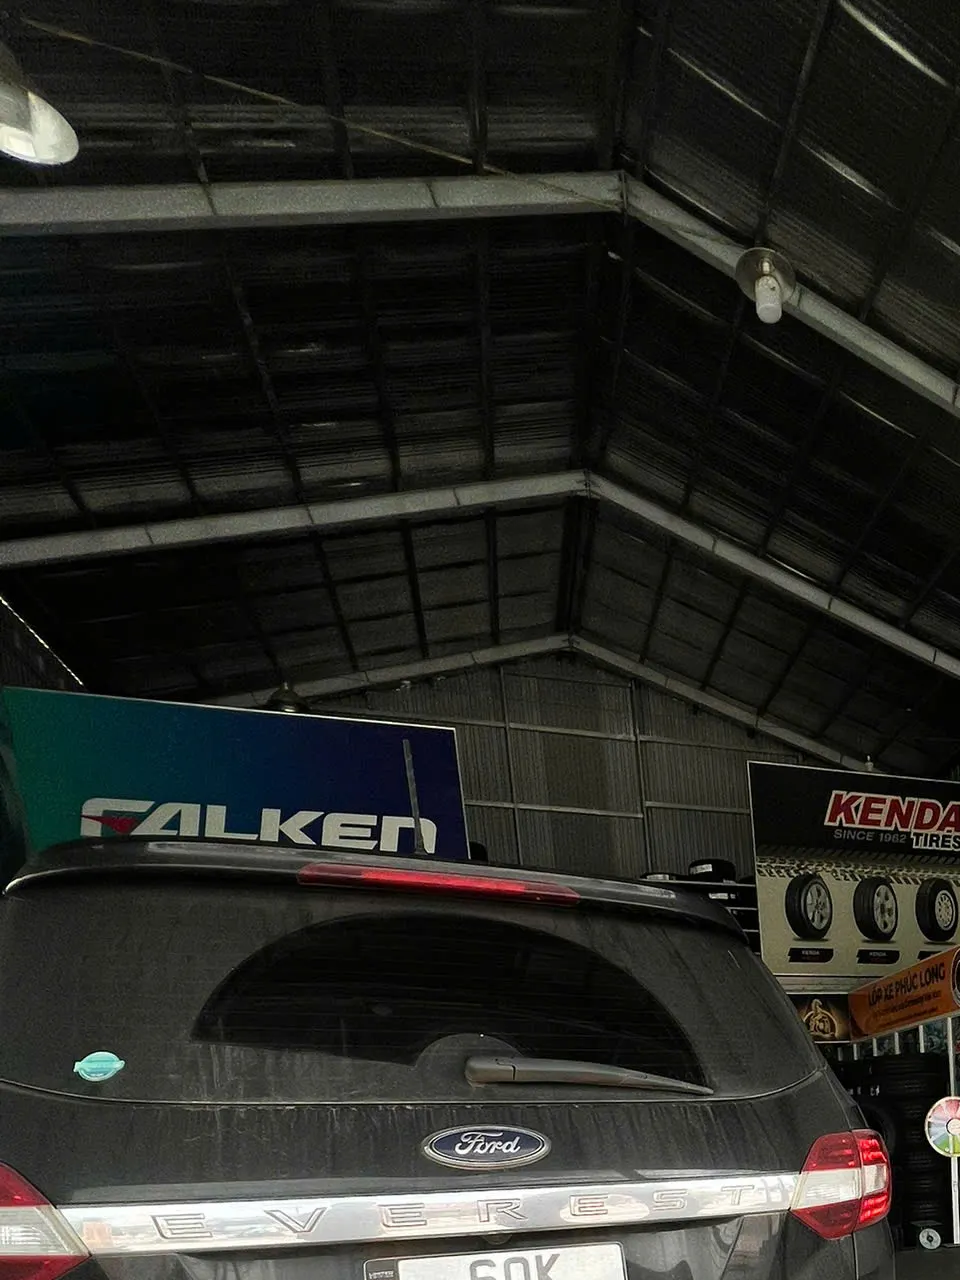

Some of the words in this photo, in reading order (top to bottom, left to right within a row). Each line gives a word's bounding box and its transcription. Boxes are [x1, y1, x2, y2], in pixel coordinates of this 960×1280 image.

[80, 797, 436, 854] FALKEN
[834, 829, 874, 841] SINCE
[919, 962, 946, 988] LONG
[454, 1131, 520, 1157] Ford
[151, 1184, 758, 1241] EVEREST
